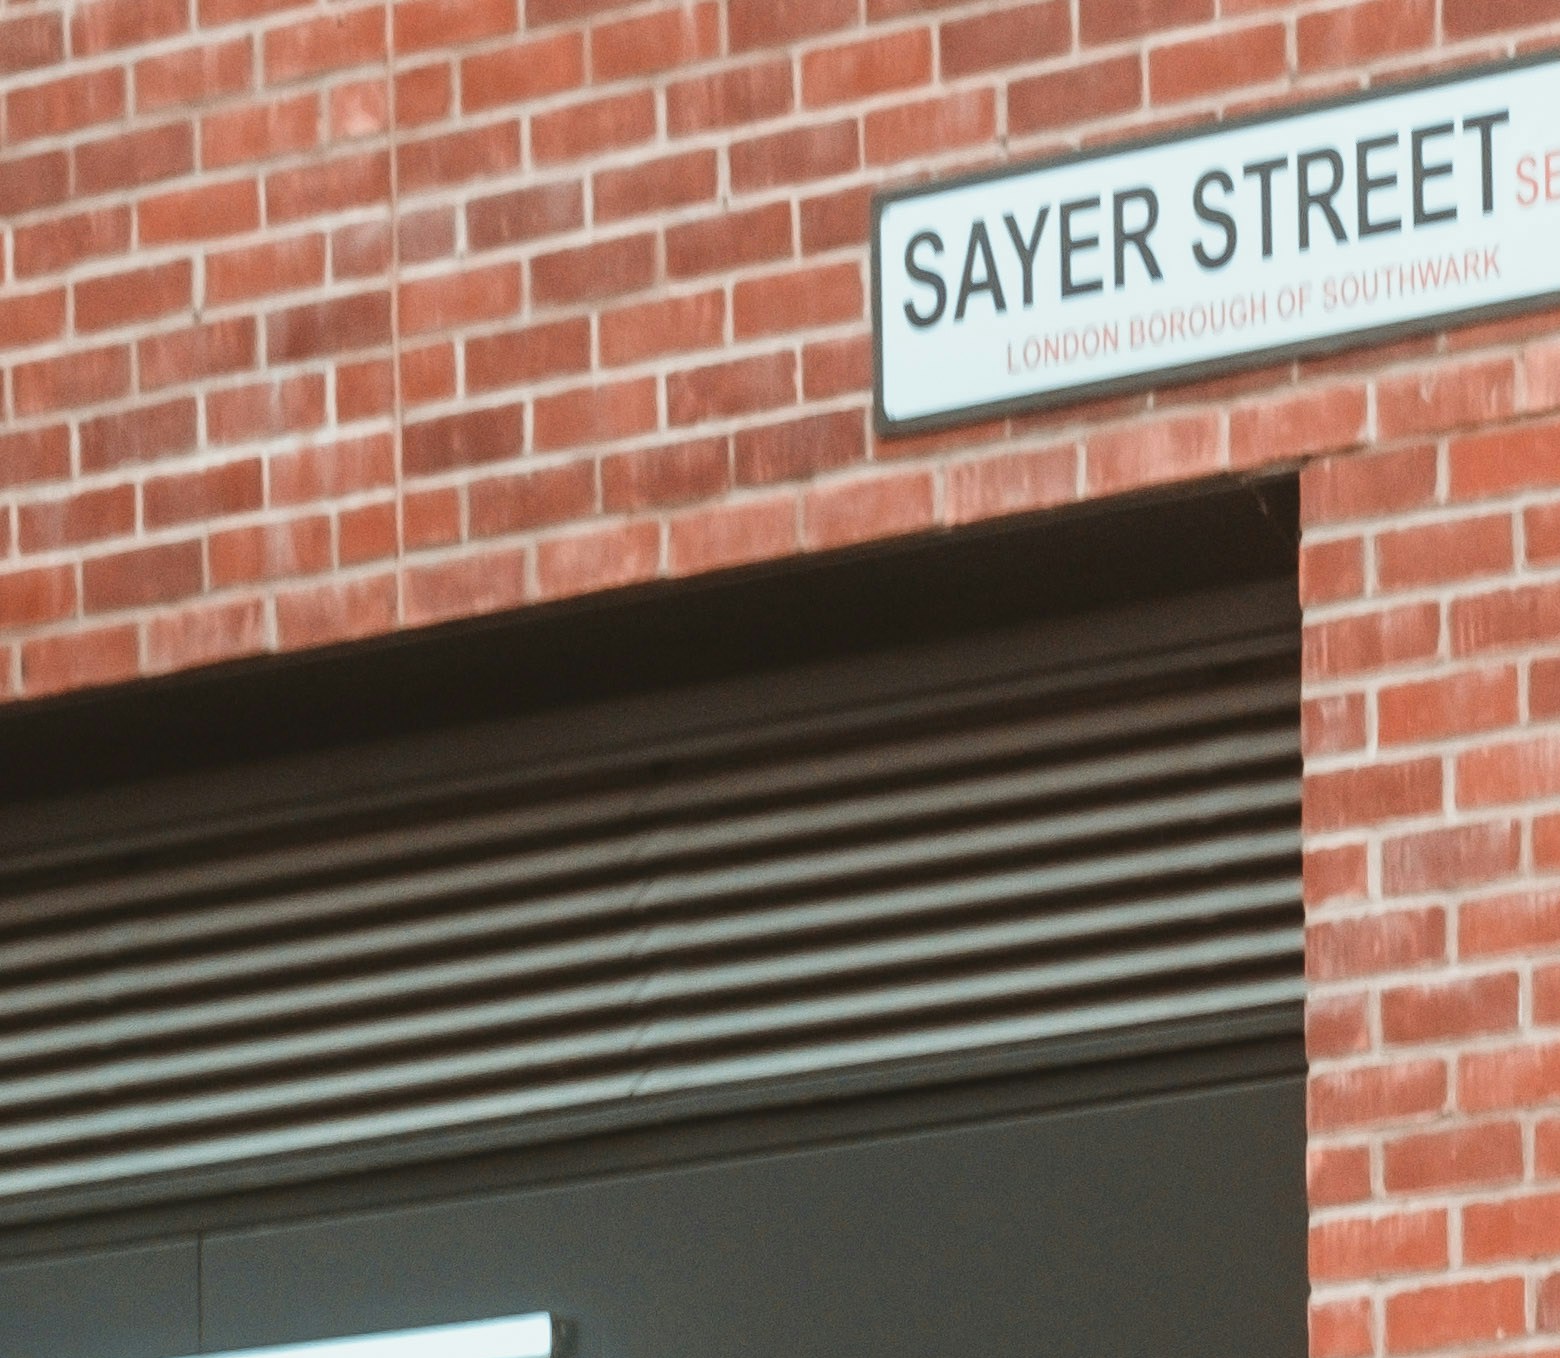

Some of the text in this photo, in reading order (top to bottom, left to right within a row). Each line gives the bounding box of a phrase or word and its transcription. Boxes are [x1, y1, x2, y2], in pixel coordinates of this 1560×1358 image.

[902, 188, 1164, 330] SAYER
[1191, 109, 1509, 271] STREET
[1006, 246, 1501, 376] LONDON BOROUGH OF SOUTHWARK
